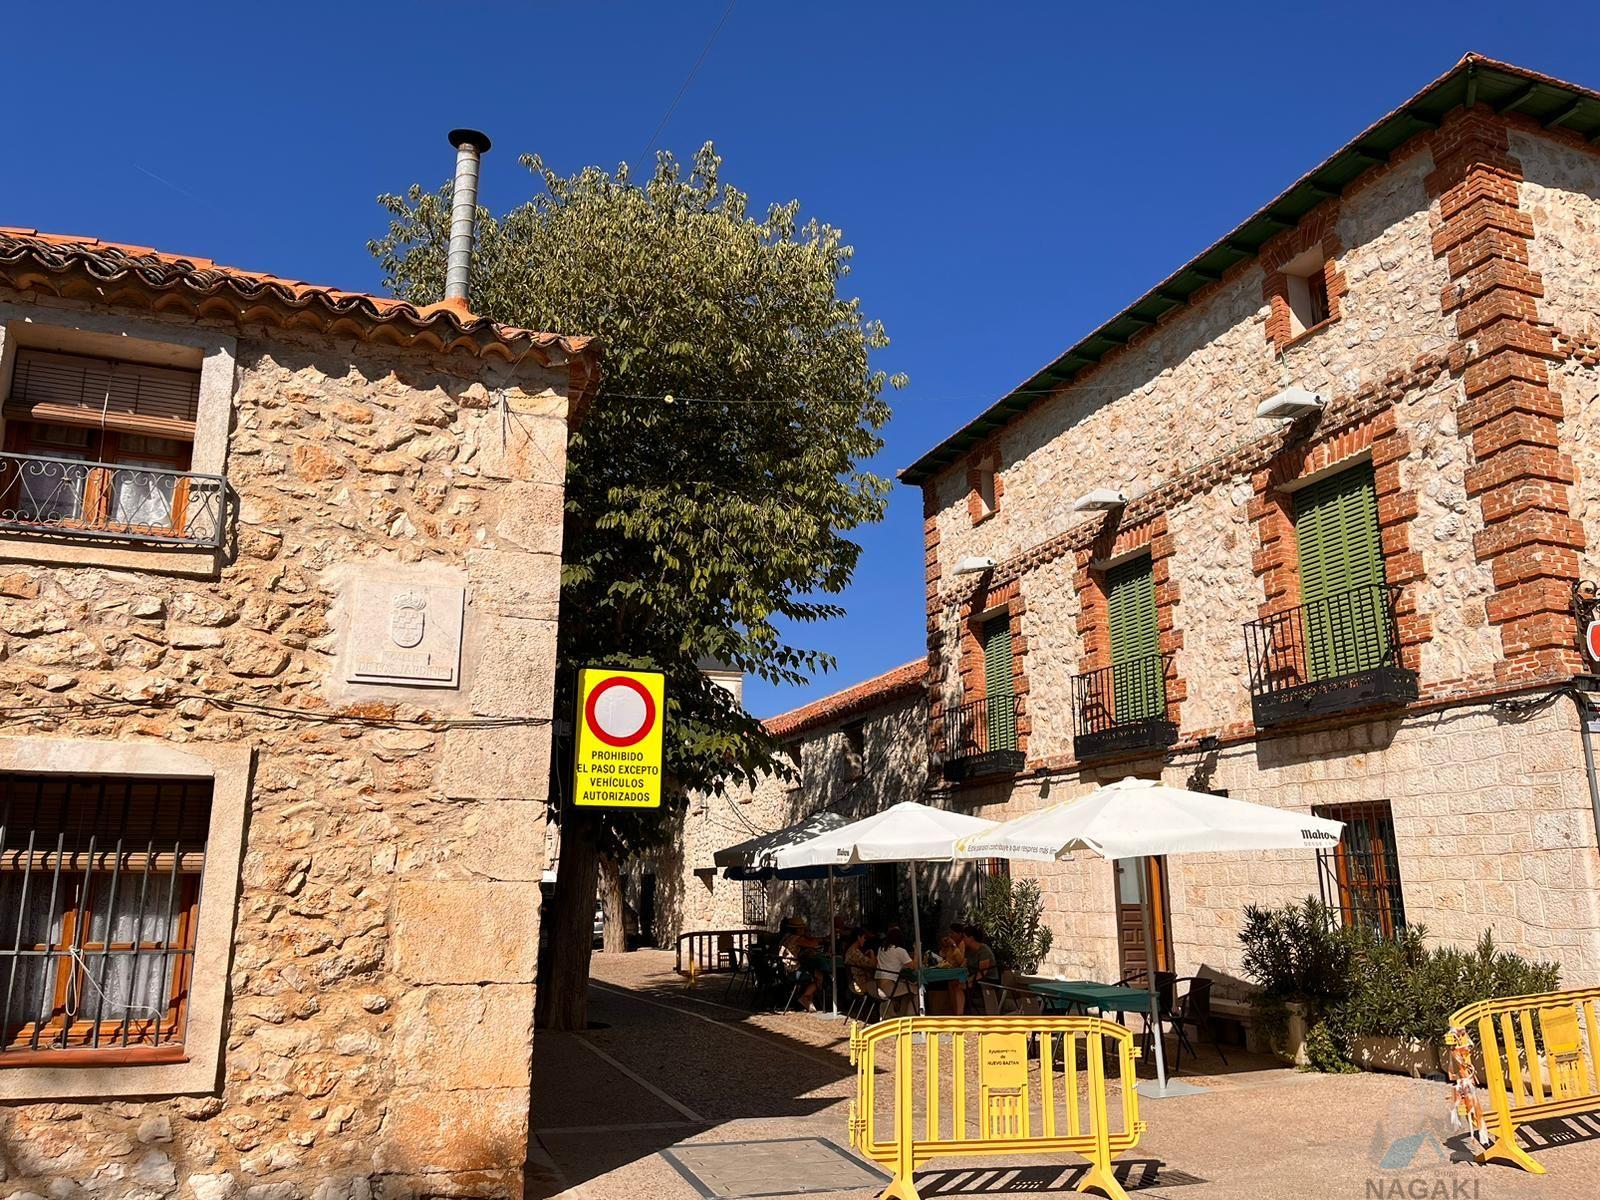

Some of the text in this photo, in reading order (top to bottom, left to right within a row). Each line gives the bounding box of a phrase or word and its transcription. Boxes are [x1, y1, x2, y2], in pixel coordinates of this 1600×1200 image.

[592, 751, 643, 761] PROHIBIDO
[577, 763, 659, 775] EL PASO EXCEPTO
[590, 777, 644, 788] VEHÍCULOS
[583, 791, 650, 801] AUTORIZADOS
